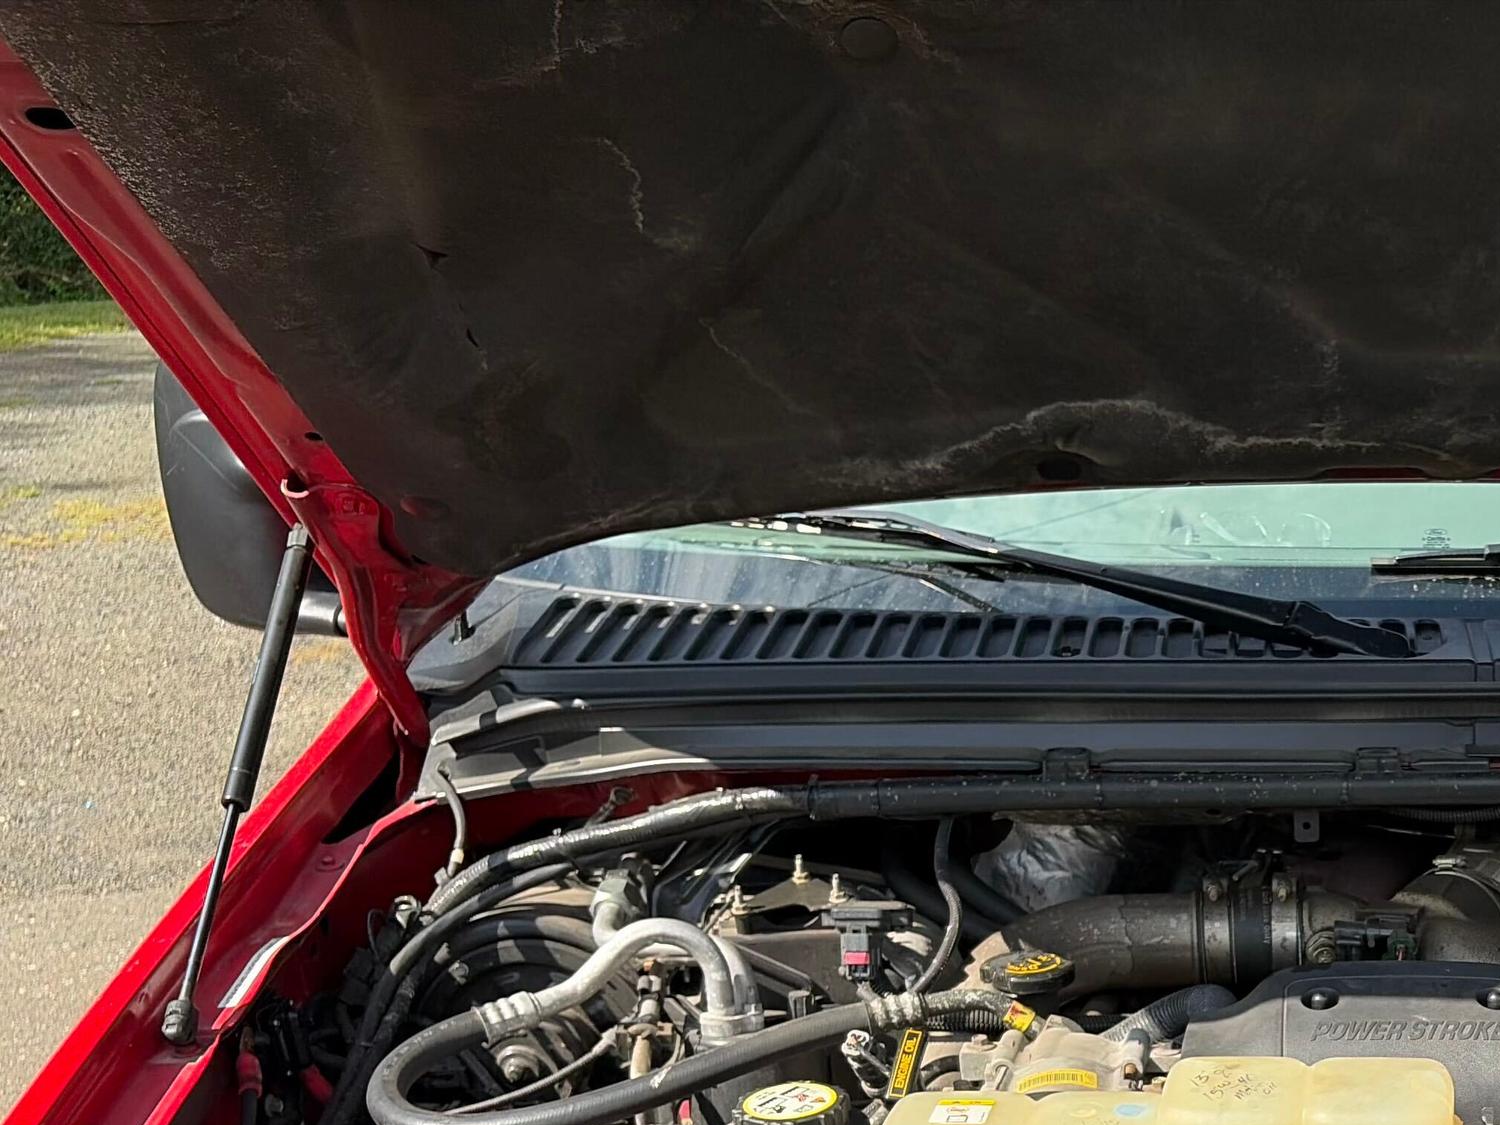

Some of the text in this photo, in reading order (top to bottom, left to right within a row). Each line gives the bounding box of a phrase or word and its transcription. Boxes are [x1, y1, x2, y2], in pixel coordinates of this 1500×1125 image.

[1310, 1020, 1408, 1041] POWER
[893, 1037, 917, 1089] ENGINE OIL
